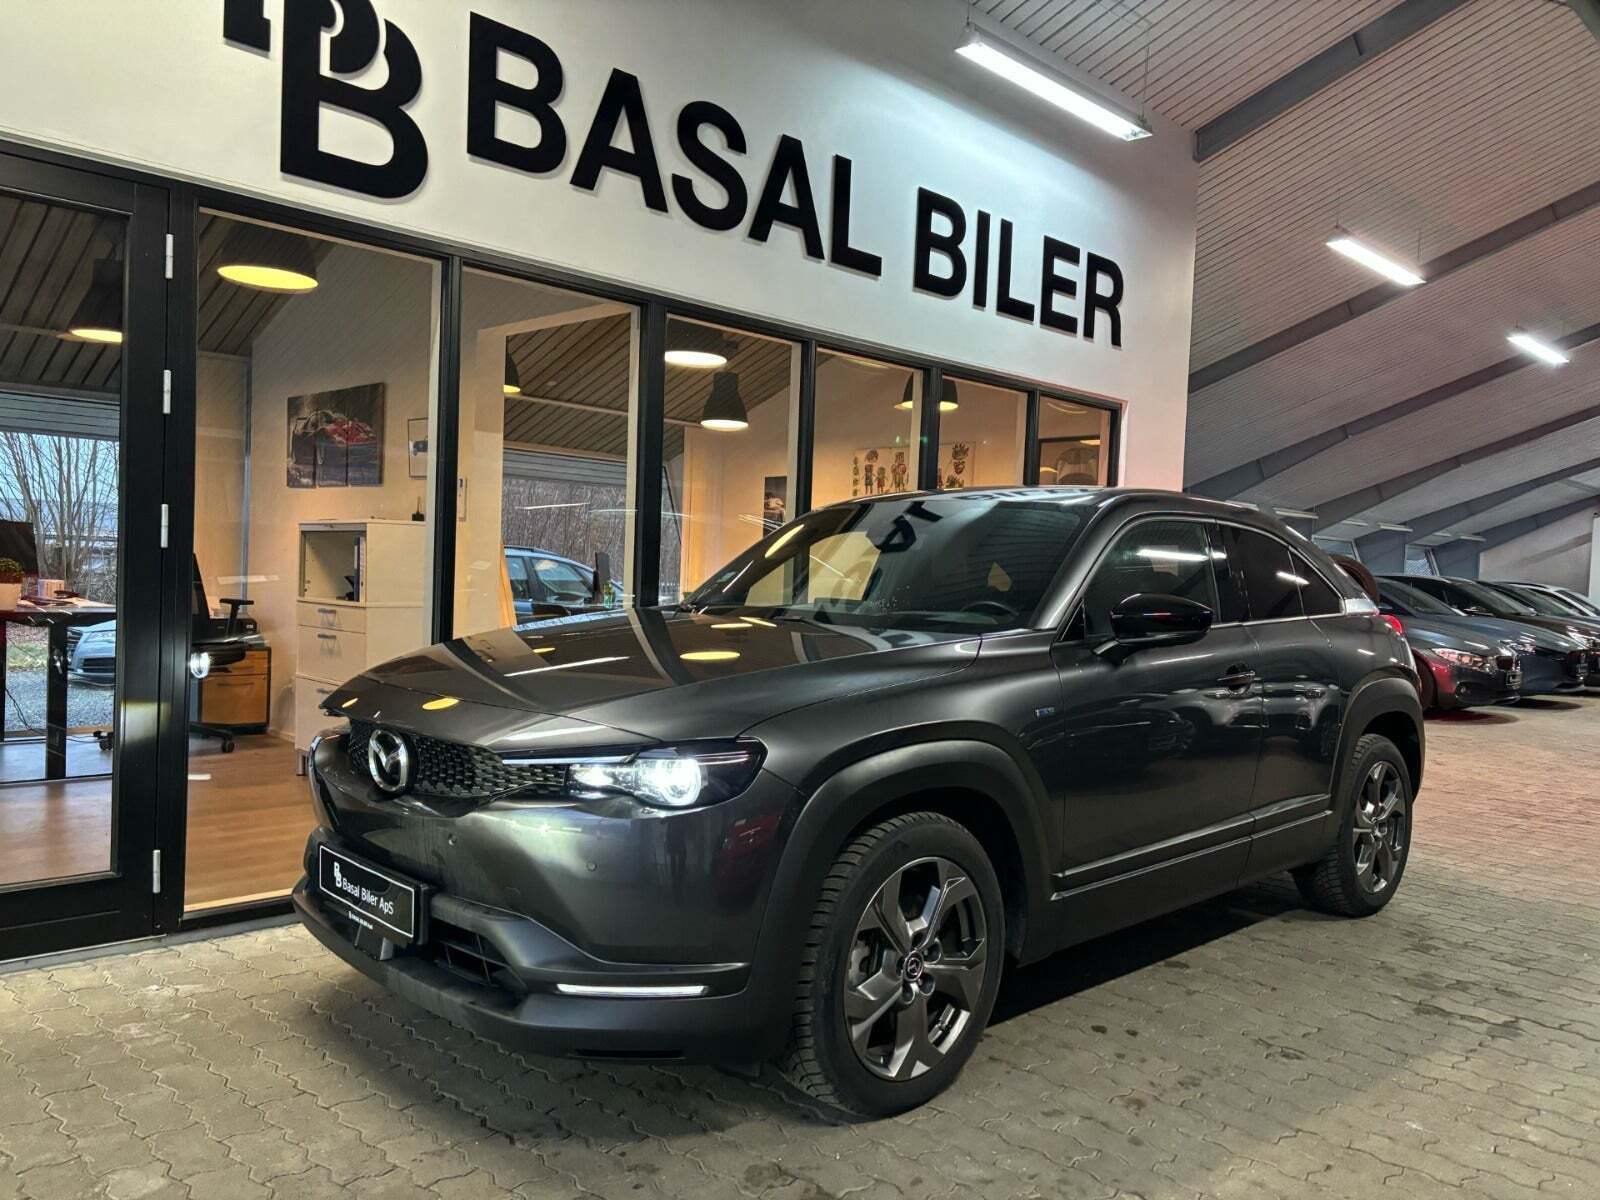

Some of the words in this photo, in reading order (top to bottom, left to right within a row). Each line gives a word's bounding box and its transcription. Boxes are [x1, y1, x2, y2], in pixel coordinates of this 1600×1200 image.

[467, 11, 882, 277] BASAL
[913, 186, 1124, 348] BILER
[342, 877, 360, 897] Basal
[379, 897, 394, 914] ApS
